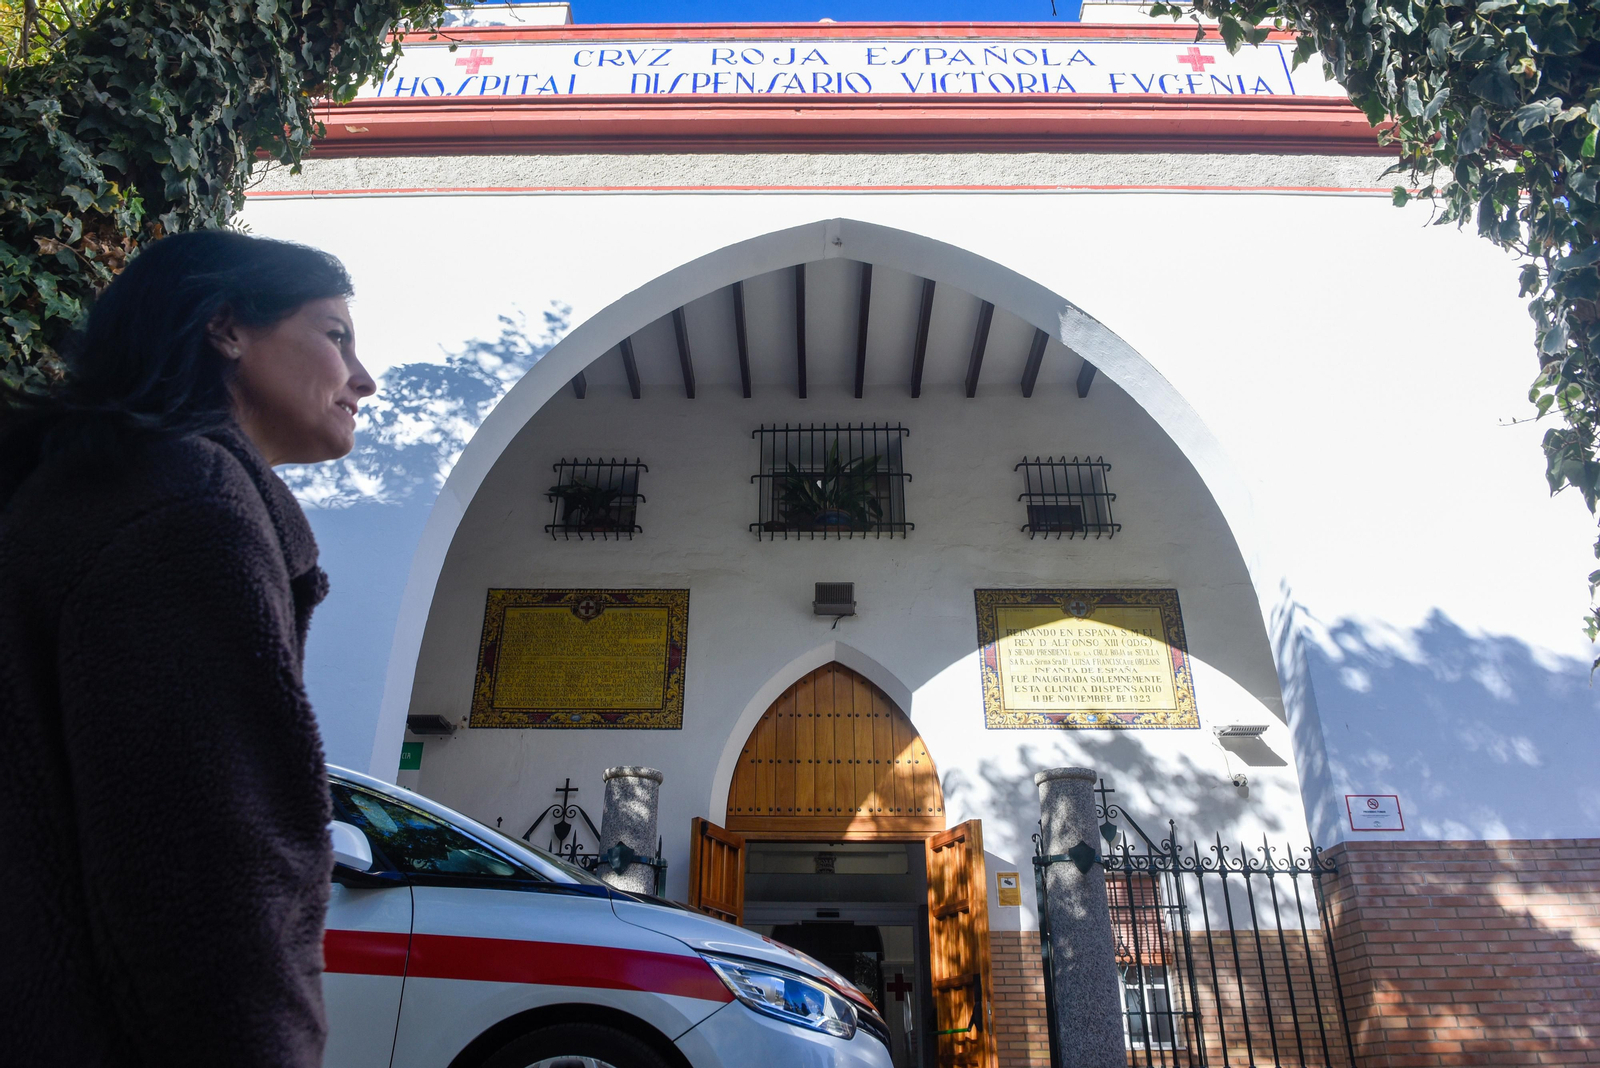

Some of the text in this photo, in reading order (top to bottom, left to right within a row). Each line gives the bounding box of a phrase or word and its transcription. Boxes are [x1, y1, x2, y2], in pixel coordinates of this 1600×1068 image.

[573, 45, 1097, 67] CRVZ ROJA ESPAÑOLA
[393, 73, 578, 97] HOSPITAL
[630, 71, 872, 95] DISPENSARIO
[900, 70, 1077, 94] VICTORIA
[1006, 628, 1056, 637] REINANDO
[1060, 629, 1073, 637] EN
[1143, 629, 1156, 637] EL
[1014, 638, 1035, 647] REY
[1051, 638, 1099, 647] ALFONSO
[1104, 638, 1119, 647] XIII
[1071, 658, 1091, 666] LUISA
[1093, 658, 1128, 666] FRANCISCA
[1097, 666, 1139, 674] ESPAÑA
[1032, 675, 1088, 683] INAUGURADA
[1090, 675, 1163, 683] SOLEMNEMENTE
[1014, 685, 1162, 693] ESTA CLINICA DISPENSARIO
[1042, 695, 1056, 703] DE
[1057, 694, 1114, 703] NOVIEMBRE
[1116, 695, 1128, 703] DE
[1130, 695, 1151, 703] 1923
